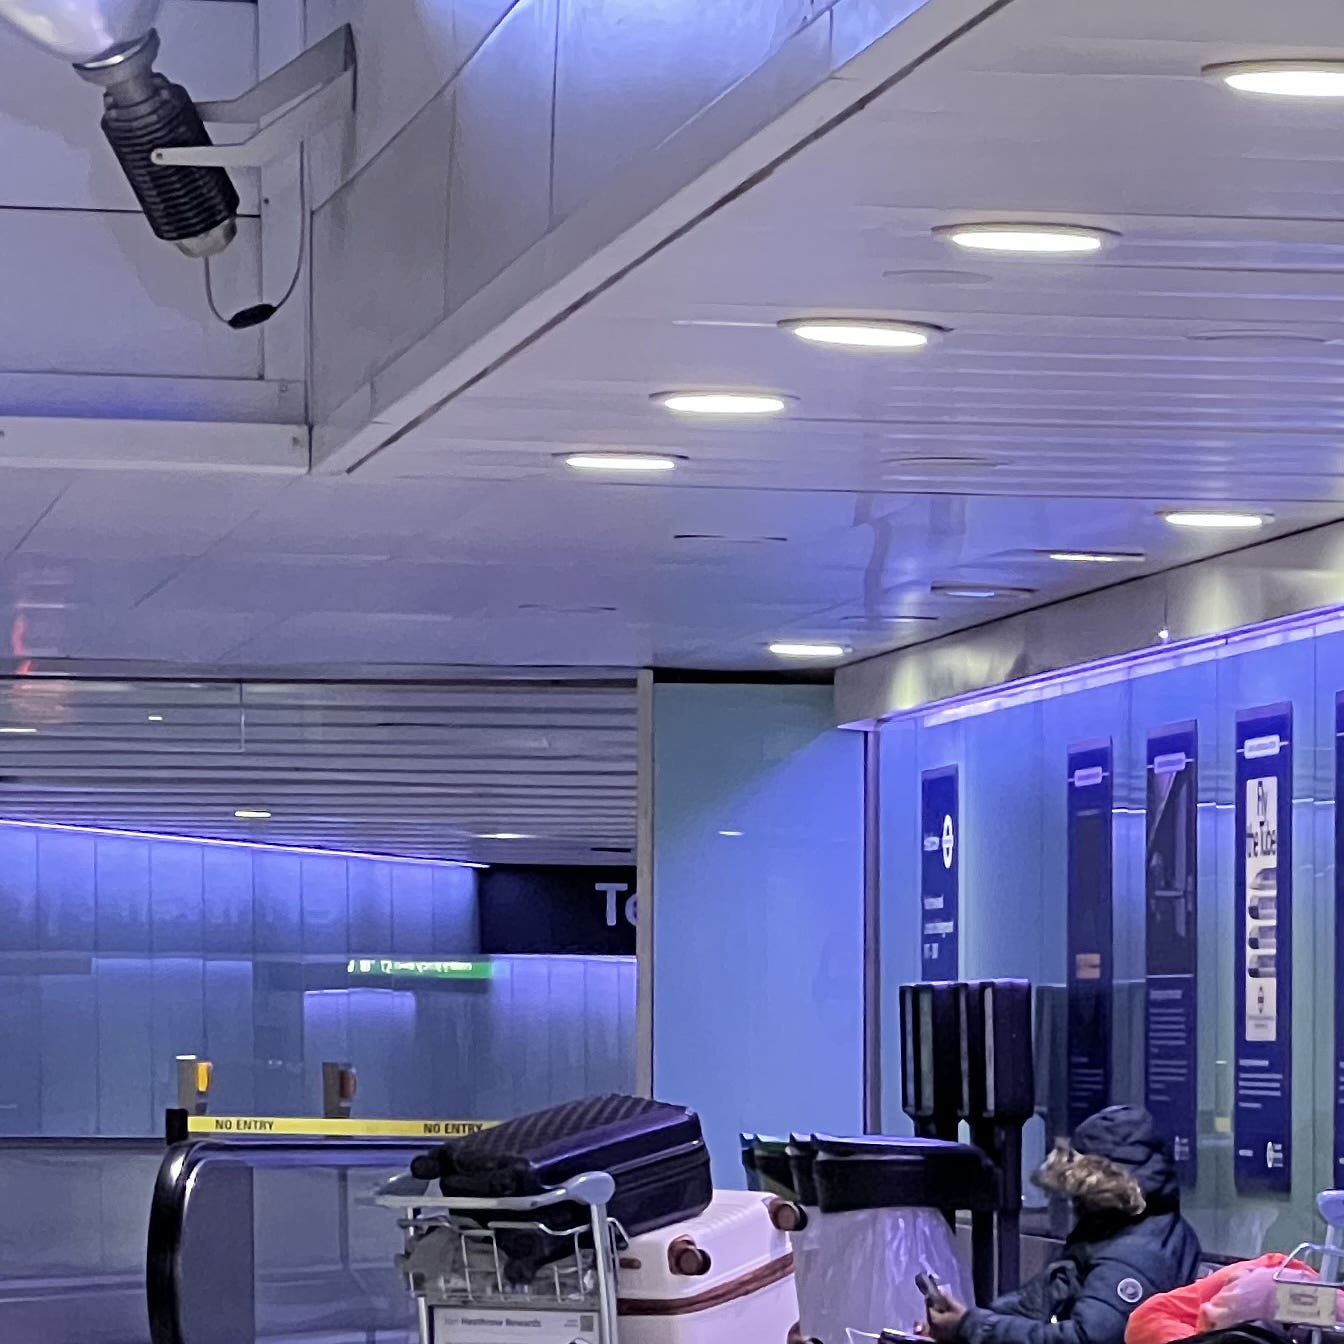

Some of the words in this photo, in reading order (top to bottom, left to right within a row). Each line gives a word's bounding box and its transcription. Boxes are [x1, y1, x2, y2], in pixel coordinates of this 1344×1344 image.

[215, 1119, 233, 1131] NO
[236, 1119, 274, 1132] ENTRY
[423, 1123, 441, 1134] NO
[444, 1123, 483, 1135] ENTRY
